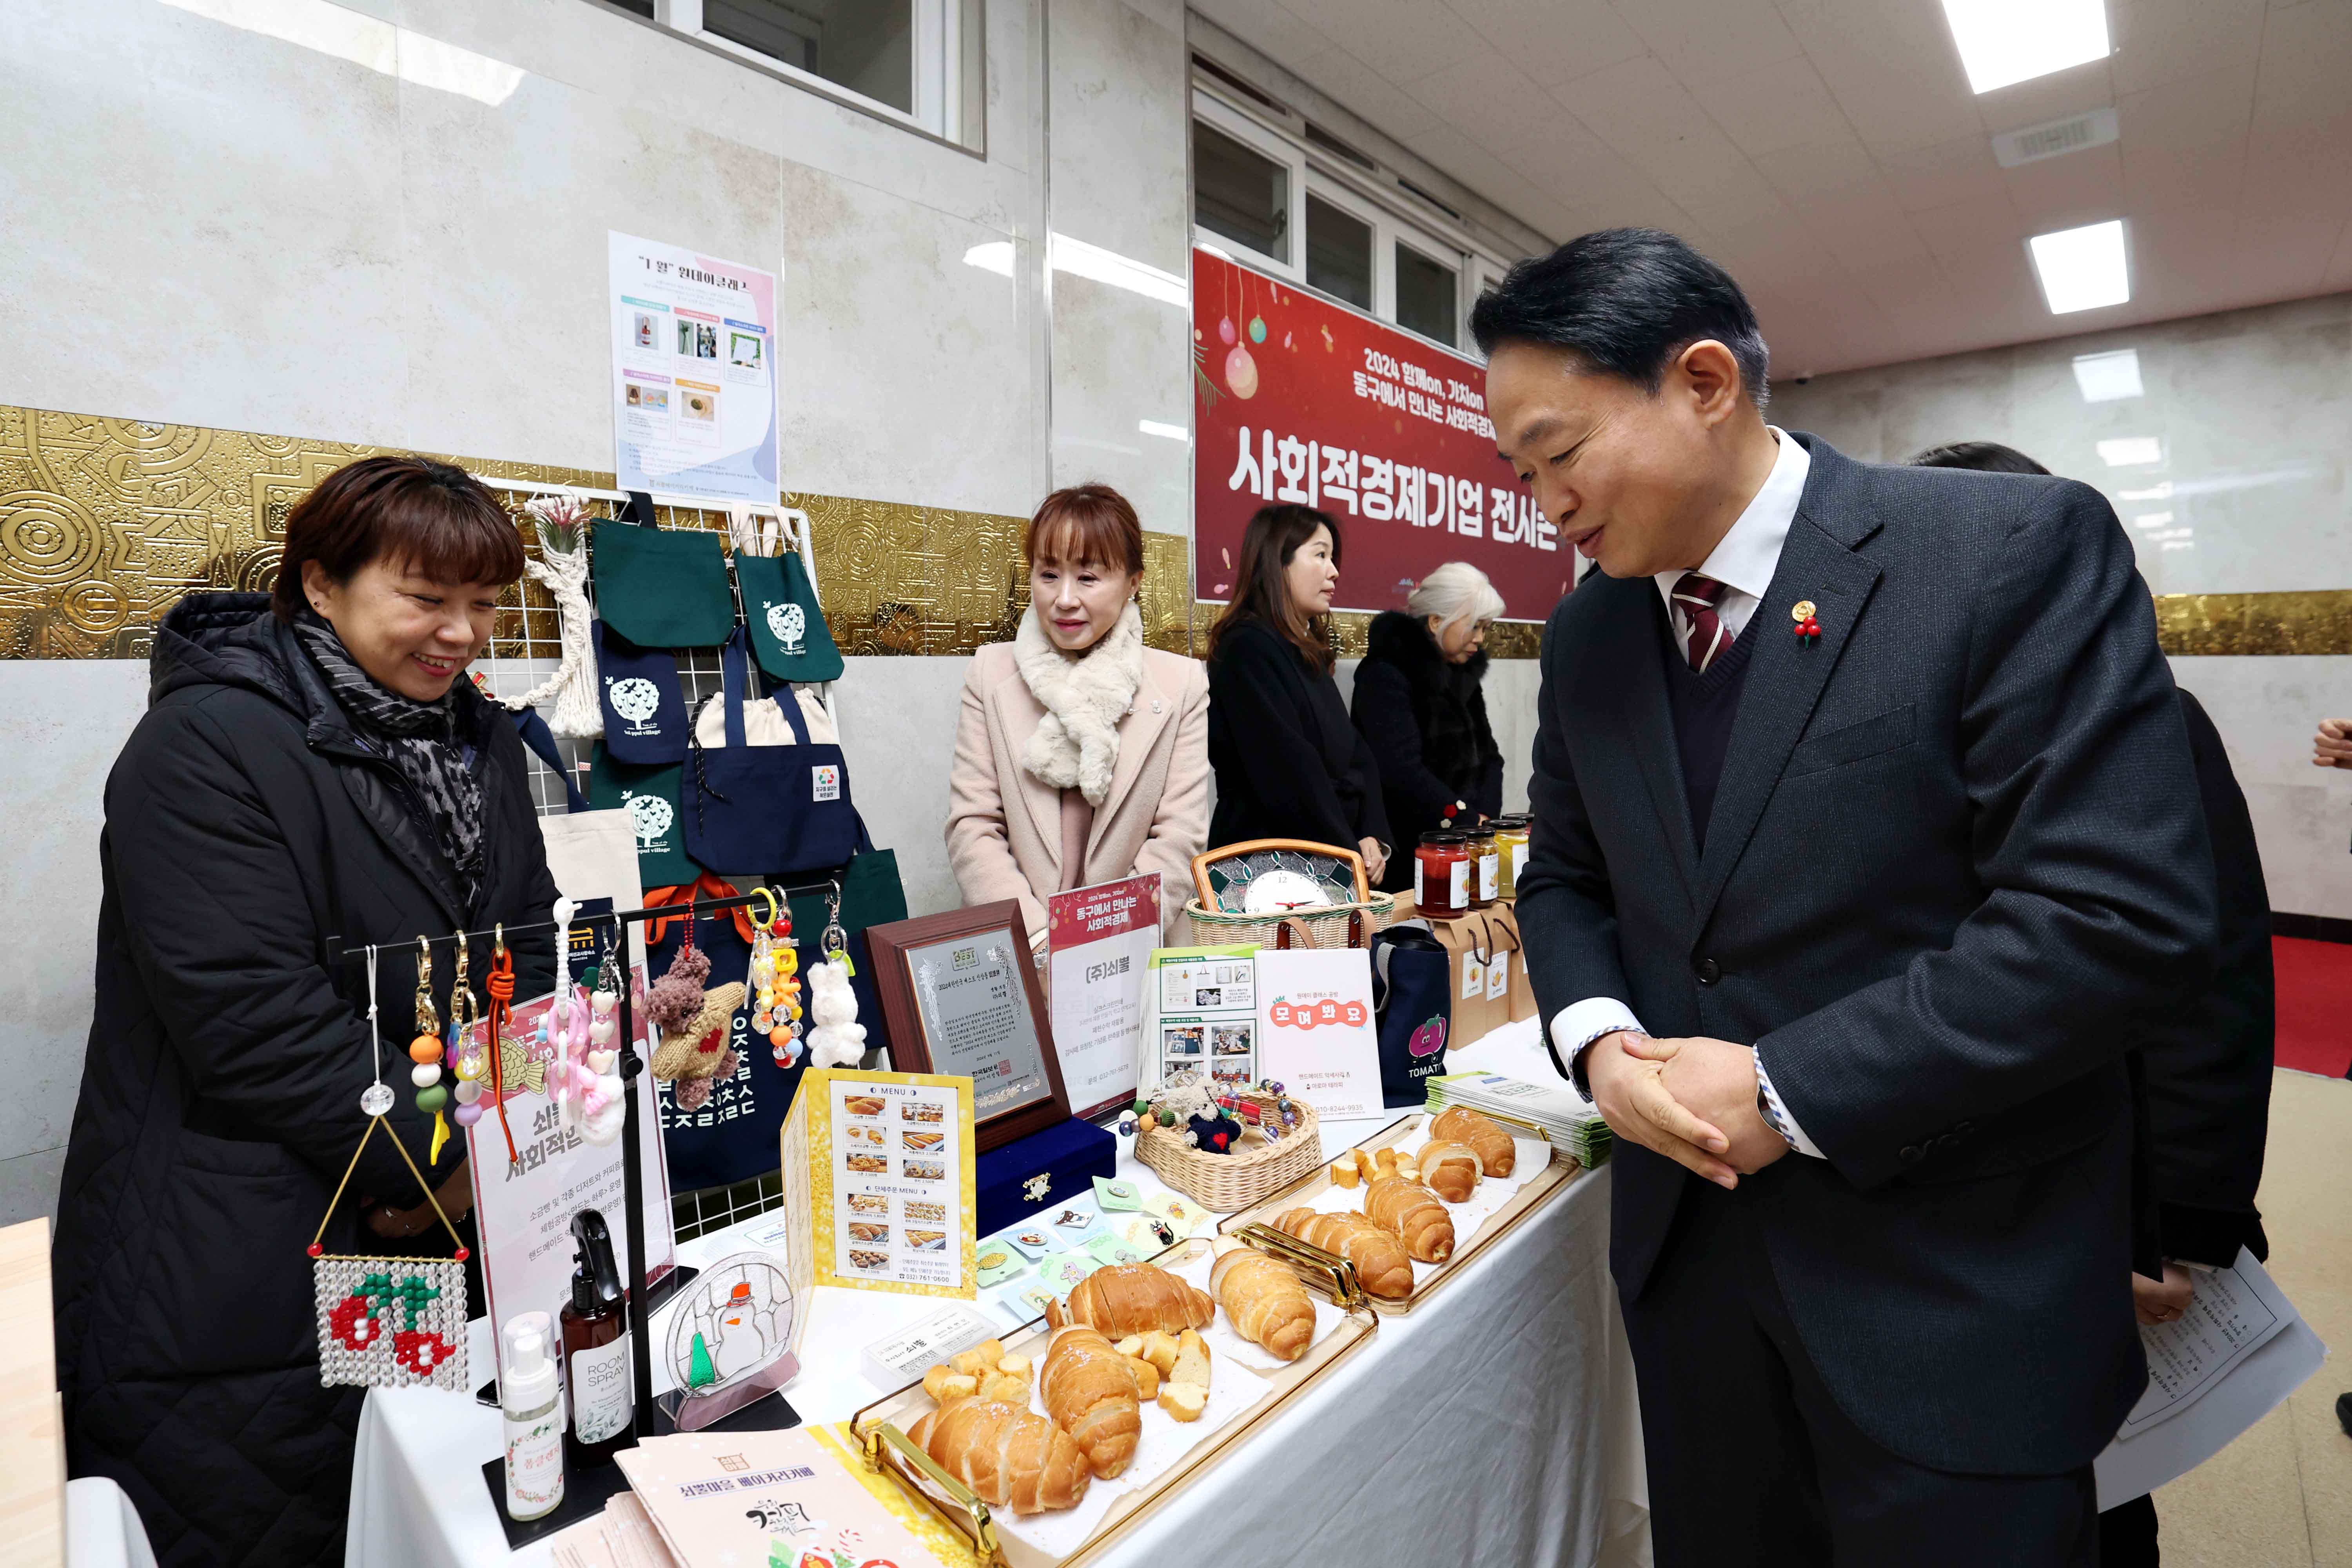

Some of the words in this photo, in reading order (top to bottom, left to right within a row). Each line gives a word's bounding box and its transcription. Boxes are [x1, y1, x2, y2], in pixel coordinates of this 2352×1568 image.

[678, 266, 751, 294] 원데이클래스
[1364, 347, 1400, 380] 2024
[1401, 361, 1446, 400] 함께on,
[1447, 379, 1484, 411] 가치on
[1353, 370, 1406, 411] 동구에서
[1408, 391, 1444, 424] 만나는
[1229, 426, 1483, 537] 사회적경제기업
[1077, 901, 1111, 920] 동구에서
[1112, 896, 1136, 911] 만나는
[1087, 911, 1128, 932] 사회적경제
[953, 951, 975, 962] BEST
[938, 978, 963, 990] 2024대한민국
[976, 972, 988, 981] 신상품
[1086, 955, 1129, 984] (주)쇠뿔
[1094, 998, 1123, 1014] 실크스크린인쇄
[1092, 1022, 1110, 1034] 폐현수막
[1111, 1017, 1124, 1027] 재활용
[1088, 1075, 1097, 1085] 문의
[1099, 1063, 1129, 1080] 032-761-5678
[1316, 1104, 1363, 1112] 010-8244-9935
[529, 1202, 551, 1222] 소금빵
[552, 1197, 559, 1207] 및
[561, 1188, 575, 1201] 각종
[576, 1172, 602, 1193] 디저트와
[592, 1188, 608, 1202] 하루>
[608, 1178, 622, 1192] 운영
[529, 1233, 564, 1261] 핸드메이드
[906, 1339, 927, 1353] 쇠뿔
[588, 1351, 624, 1375] ROOM
[588, 1362, 625, 1387] SPRAY
[680, 1479, 736, 1497] 쇠뿔마을
[737, 1466, 815, 1487] 베이커리카페
